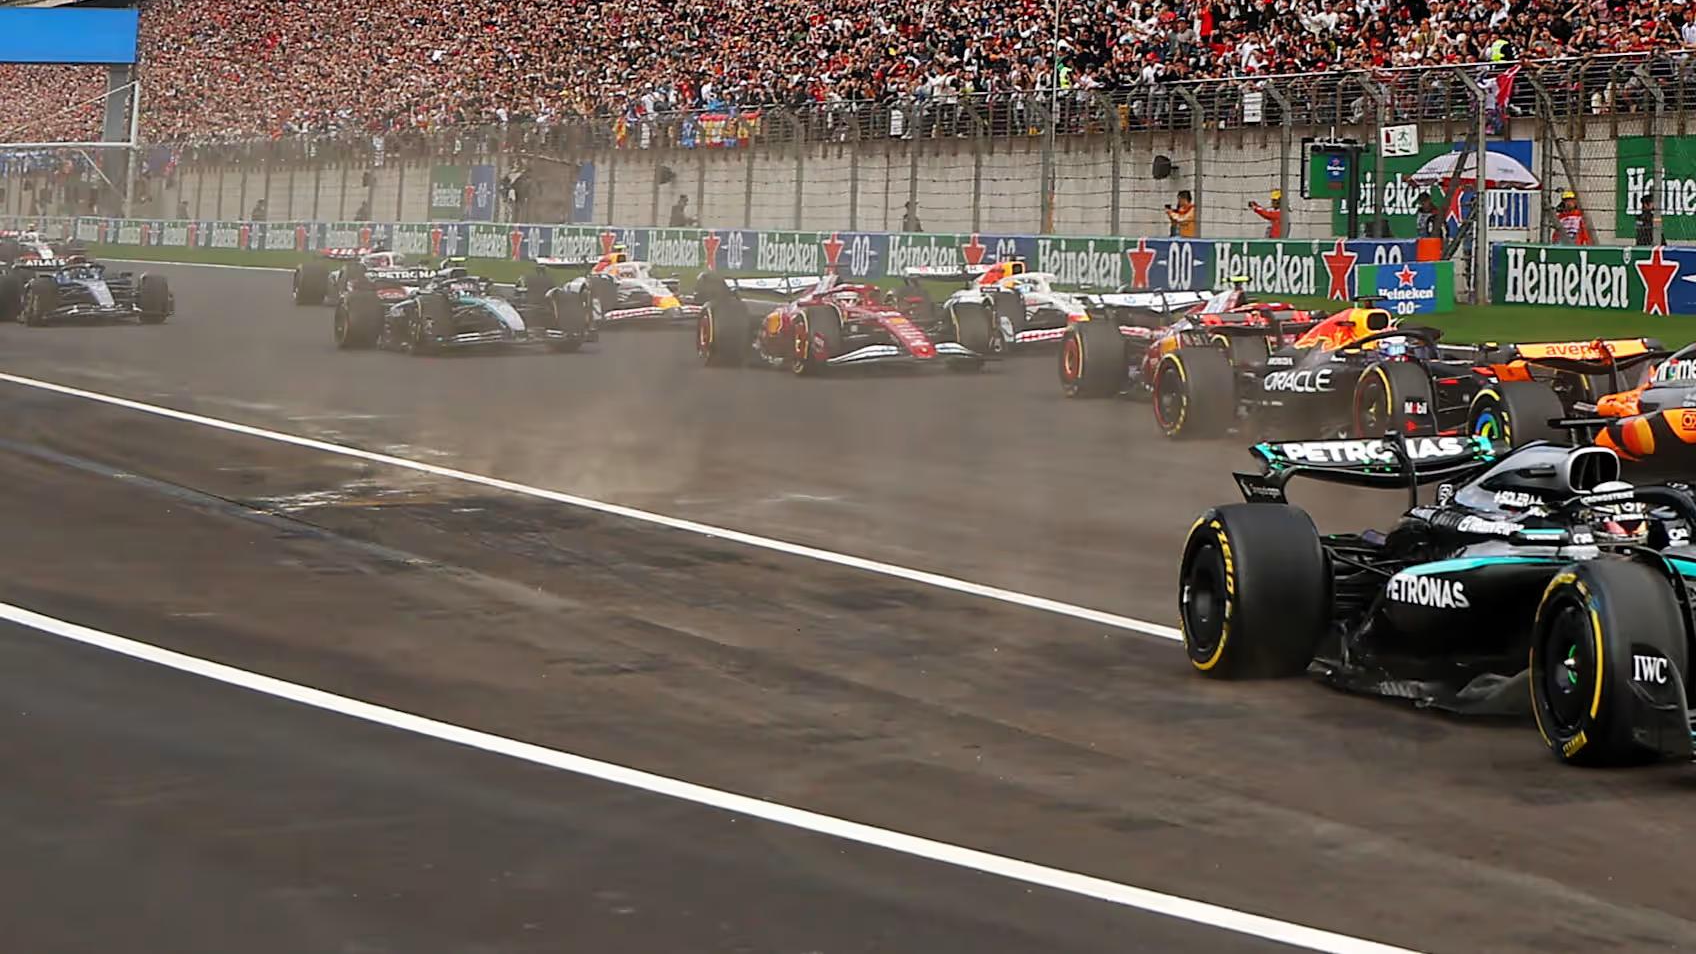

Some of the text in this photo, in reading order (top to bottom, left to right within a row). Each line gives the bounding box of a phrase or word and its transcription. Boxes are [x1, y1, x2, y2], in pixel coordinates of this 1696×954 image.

[756, 232, 870, 276] Heineken 0.0
[886, 235, 957, 276] Heineken
[1037, 239, 1122, 289] Heineken
[1167, 242, 1193, 290] 0.0
[1213, 242, 1317, 295] Heineken
[377, 270, 438, 279] PETRONA
[1504, 247, 1630, 308] Heineken
[1378, 287, 1433, 300] Heineken
[1263, 368, 1334, 393] ORACLE
[1404, 401, 1427, 414] Mobil
[1386, 572, 1471, 609] PETRONAS
[1633, 655, 1668, 684] IWC
